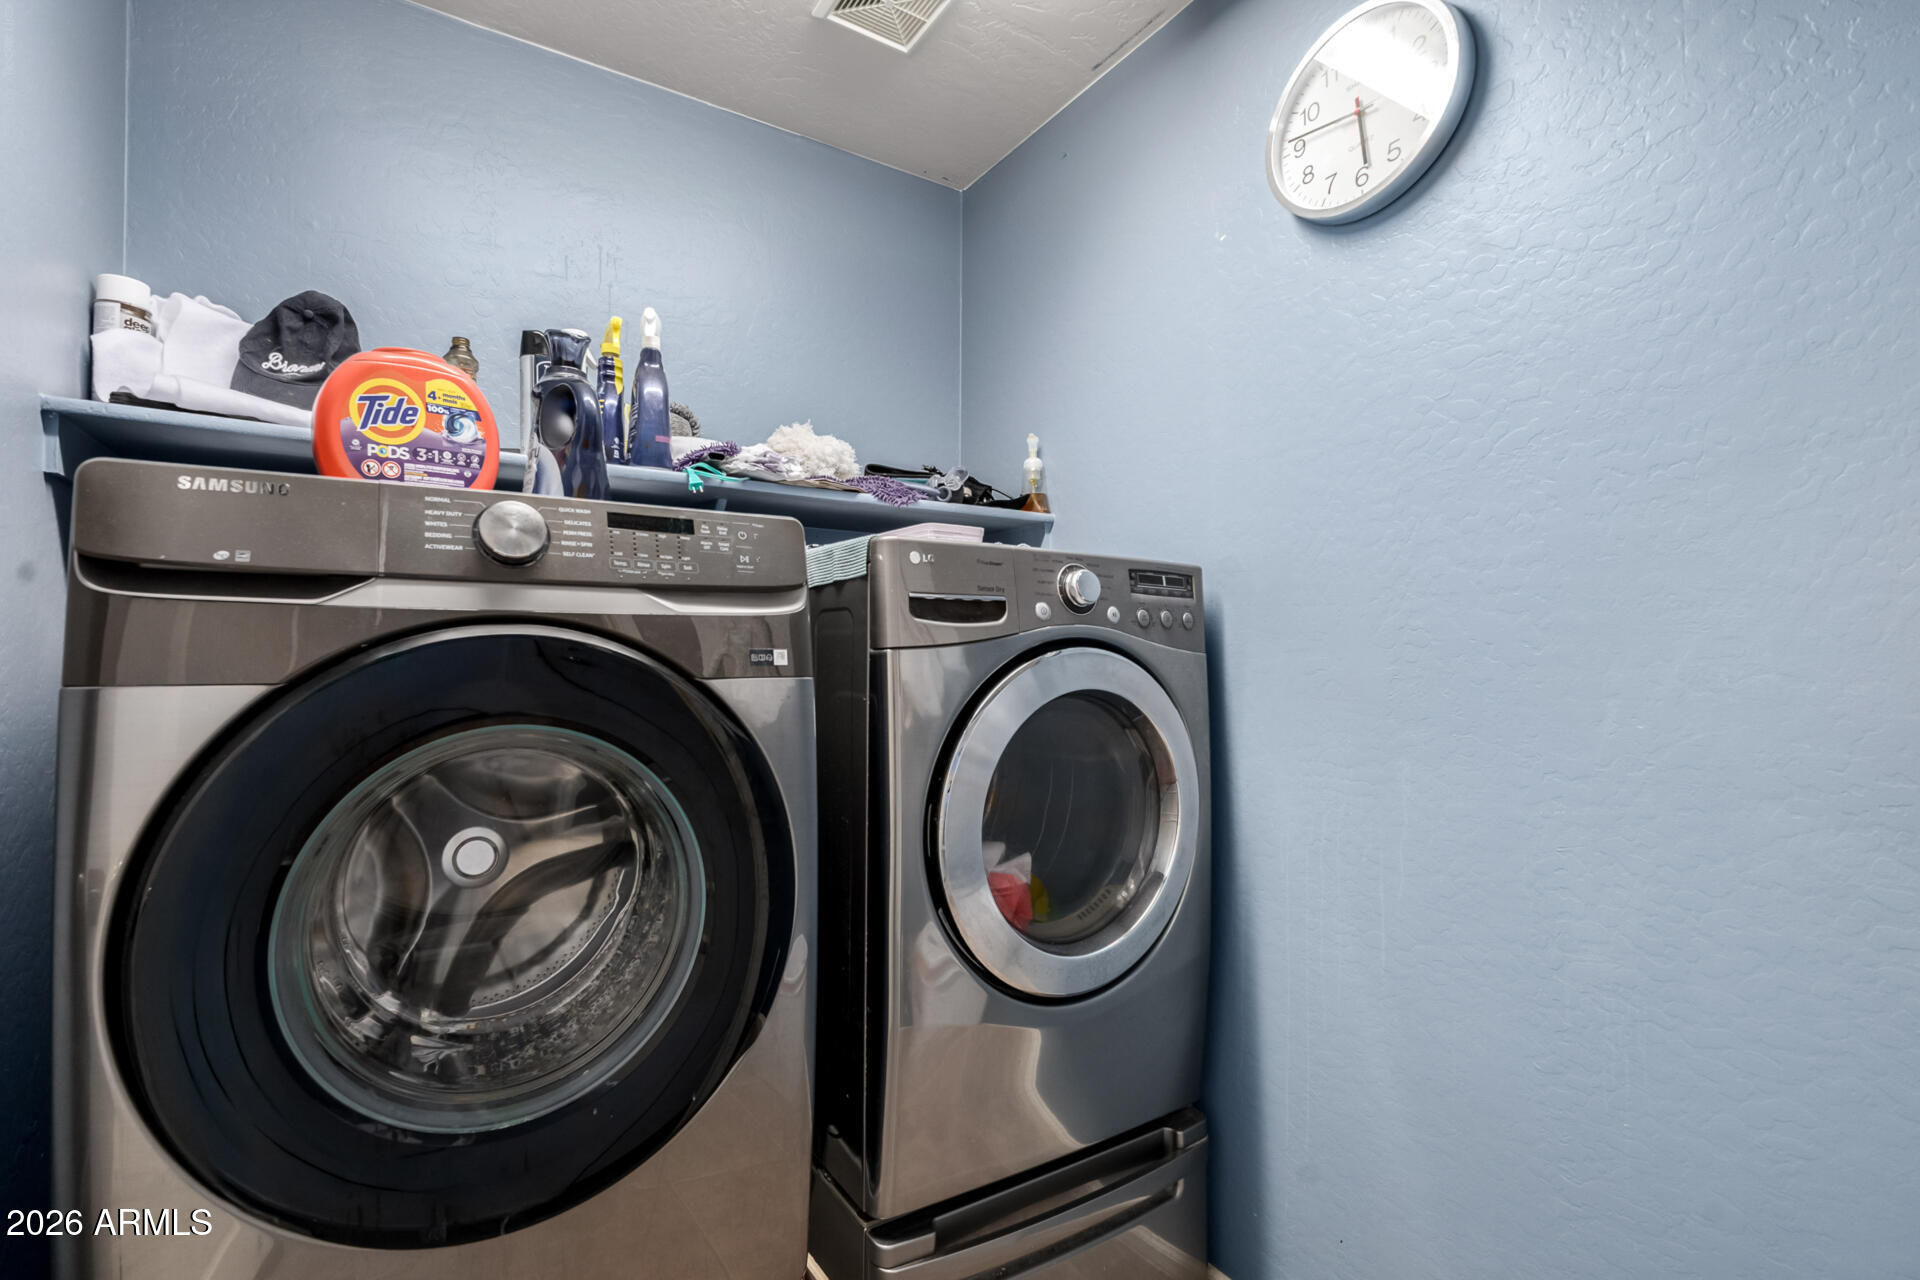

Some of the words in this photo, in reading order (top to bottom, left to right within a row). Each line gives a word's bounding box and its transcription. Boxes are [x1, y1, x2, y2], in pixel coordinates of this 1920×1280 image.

[1300, 102, 1320, 126] 10
[1293, 138, 1306, 159] 9
[1387, 139, 1401, 162] 5
[1302, 165, 1315, 185] 8
[1325, 172, 1338, 195] 7
[1355, 166, 1369, 188] 6
[356, 392, 420, 432] Tide
[177, 475, 290, 496] SAMSUNG
